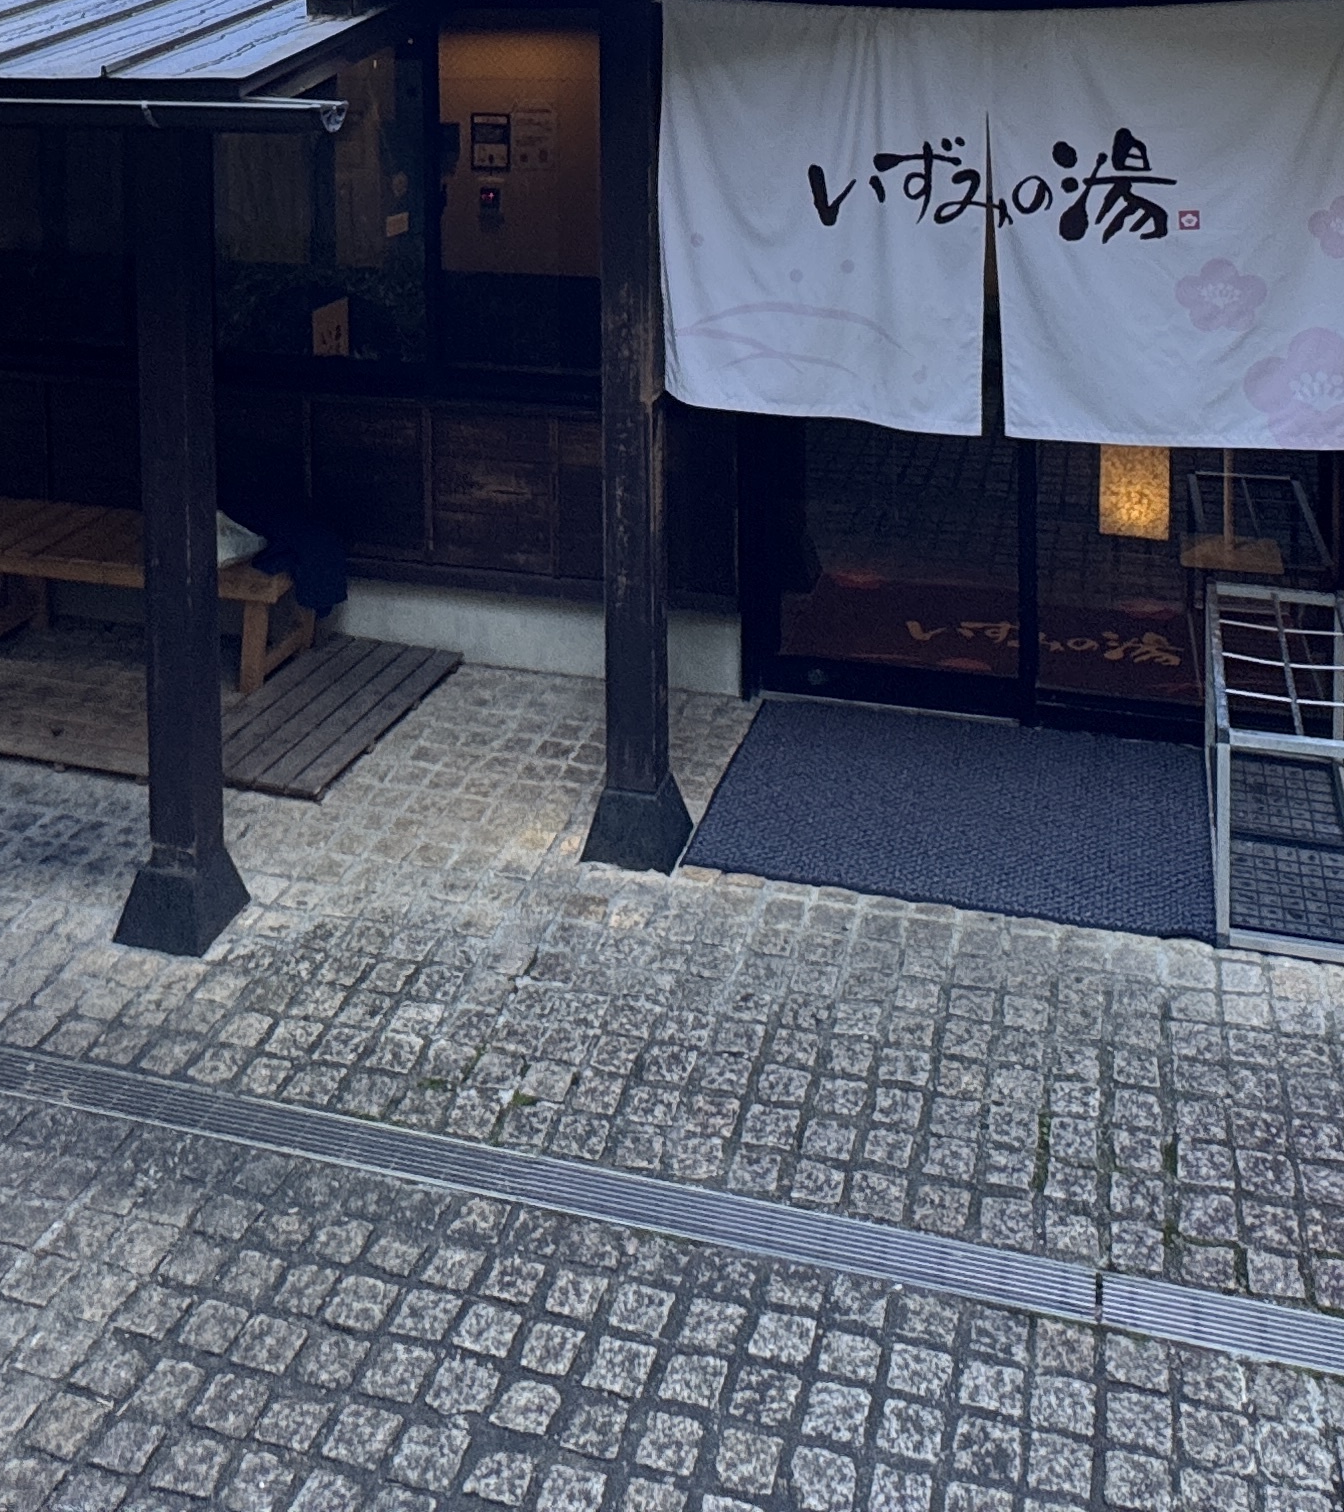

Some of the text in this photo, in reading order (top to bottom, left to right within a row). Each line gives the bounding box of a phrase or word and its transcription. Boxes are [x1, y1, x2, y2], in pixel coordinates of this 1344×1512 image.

[807, 126, 1178, 245] いずみの湯
